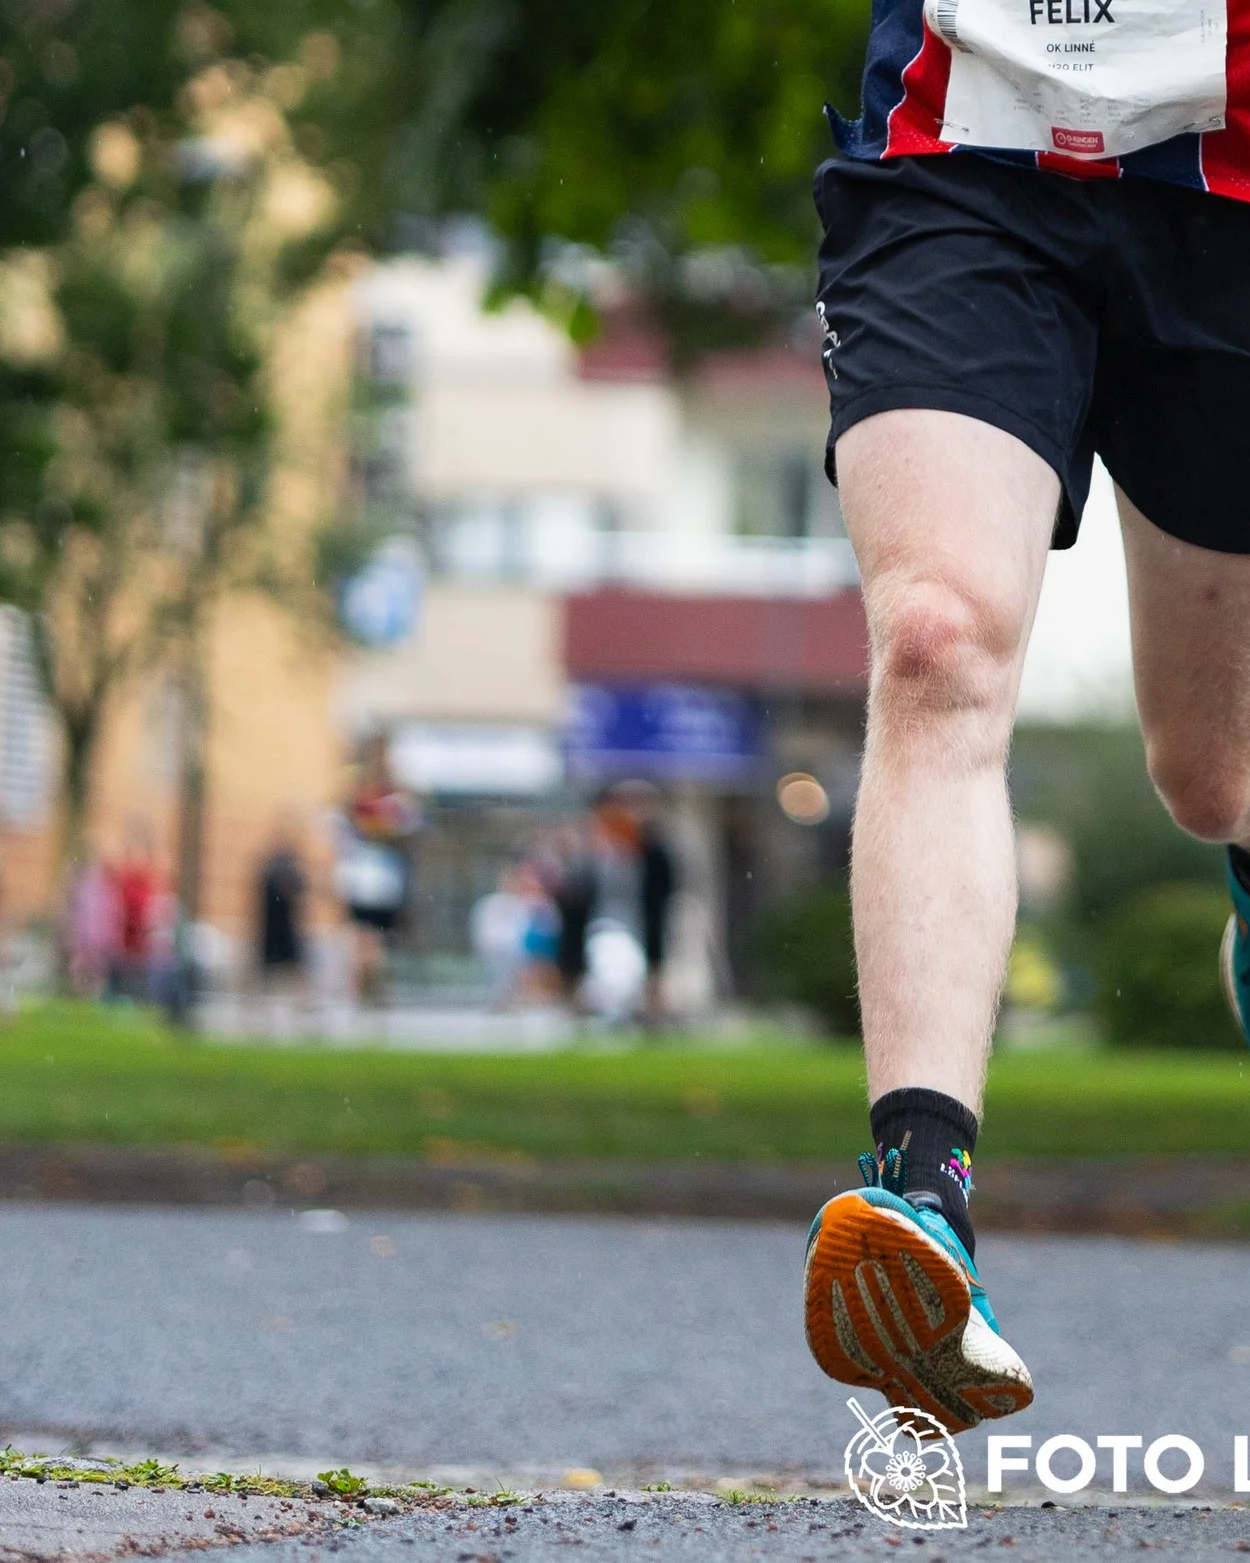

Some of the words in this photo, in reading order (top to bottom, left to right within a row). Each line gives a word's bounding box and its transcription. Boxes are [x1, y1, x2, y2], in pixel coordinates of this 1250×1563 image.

[1046, 43, 1061, 53] OK
[1064, 40, 1096, 53] LINNÉ
[1072, 63, 1094, 71] ELIT
